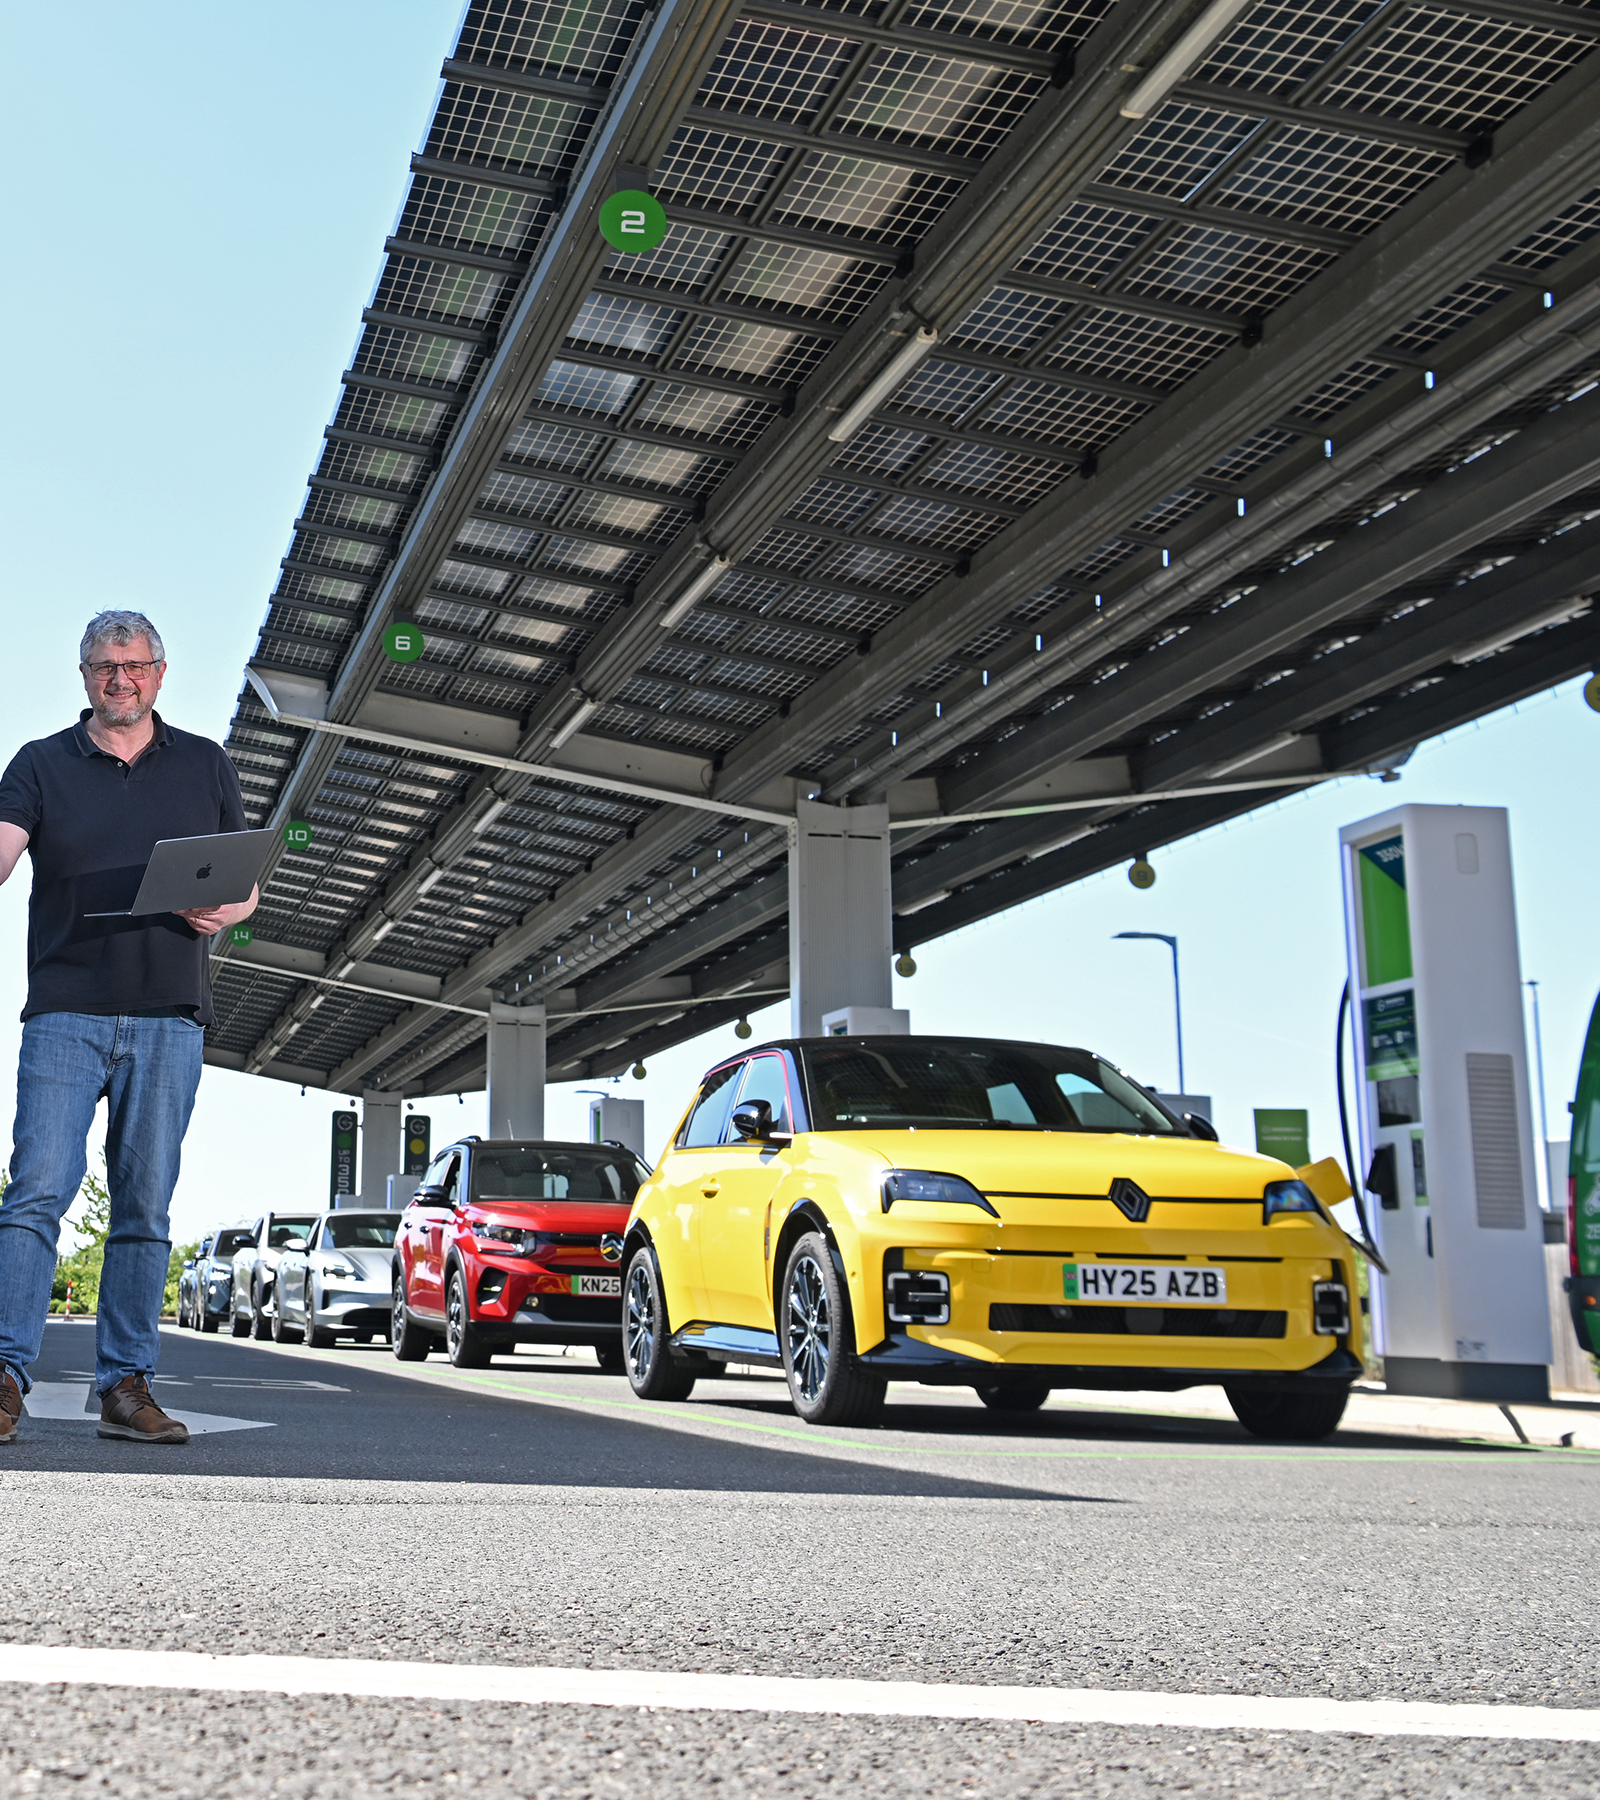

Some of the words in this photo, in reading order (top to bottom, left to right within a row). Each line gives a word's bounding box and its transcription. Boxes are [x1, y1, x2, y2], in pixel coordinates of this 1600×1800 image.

[621, 210, 645, 234] 2
[395, 635, 411, 651] 6
[288, 829, 308, 842] 10
[234, 930, 249, 940] 14
[581, 1277, 620, 1293] KN25
[1082, 1268, 1157, 1296] HY25
[1167, 1271, 1219, 1298] AZB
